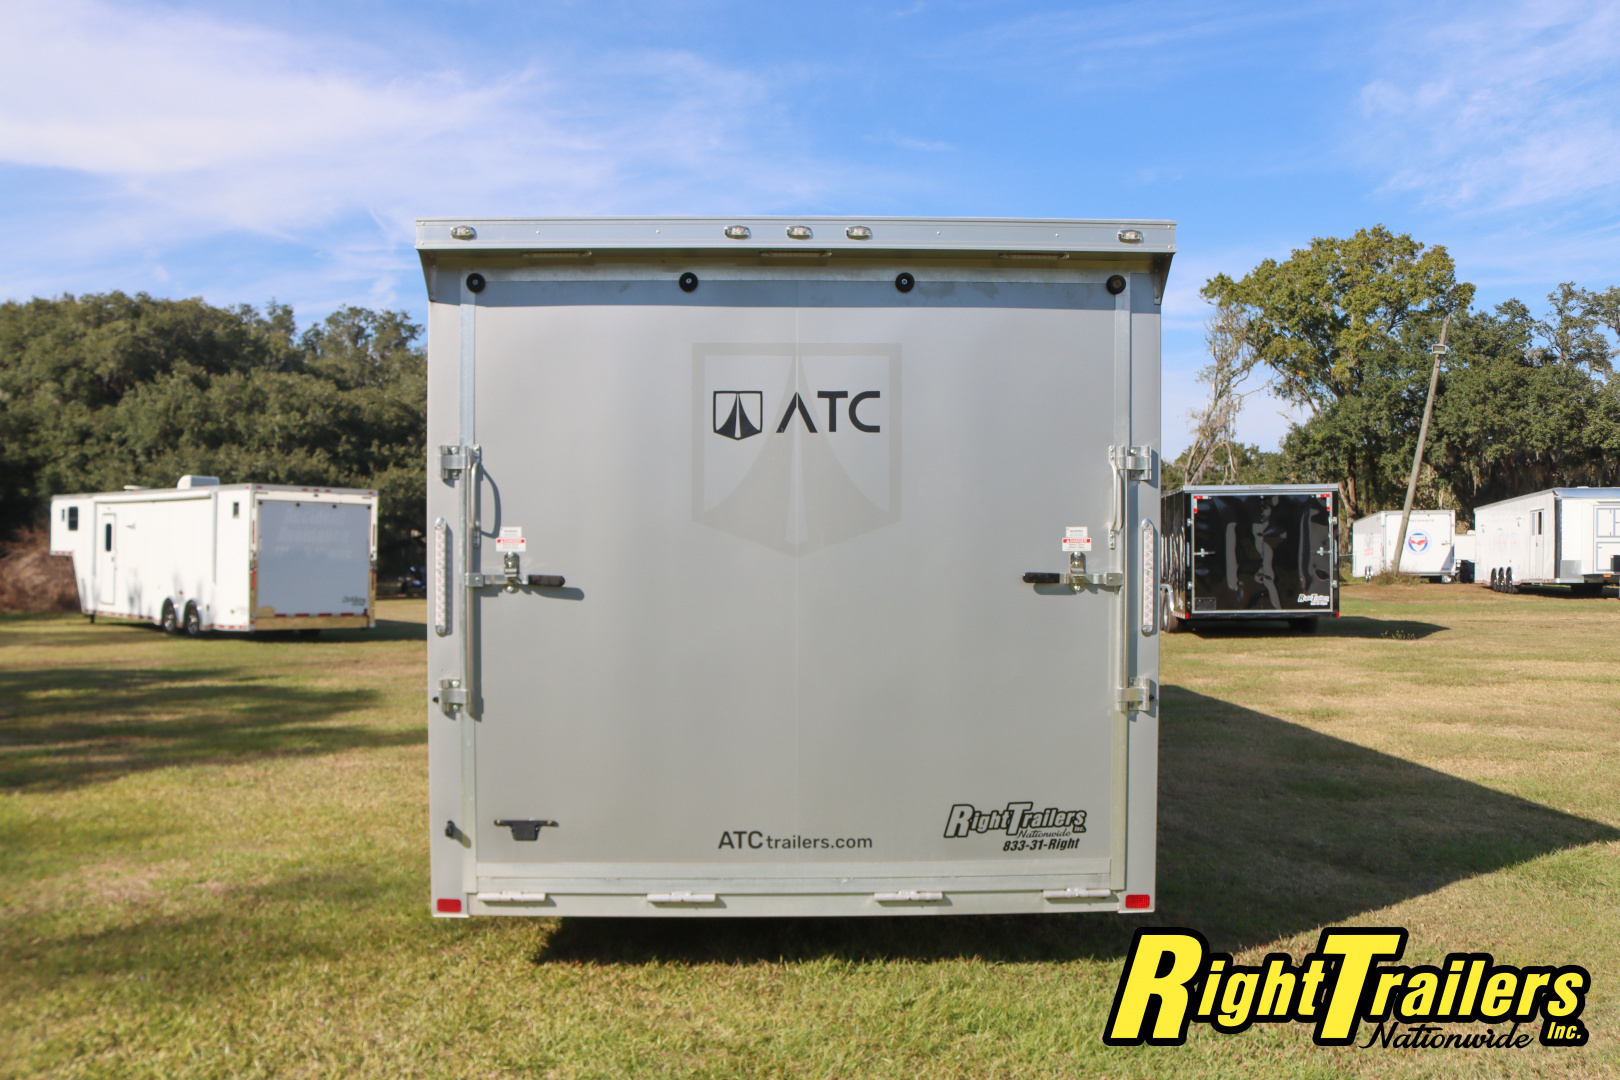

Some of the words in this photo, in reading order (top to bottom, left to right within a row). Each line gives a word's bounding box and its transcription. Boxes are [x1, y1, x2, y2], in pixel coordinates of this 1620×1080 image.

[776, 390, 880, 433] ATC
[1016, 827, 1072, 839] Nationwide
[1003, 838, 1080, 851] 833-31-Right
